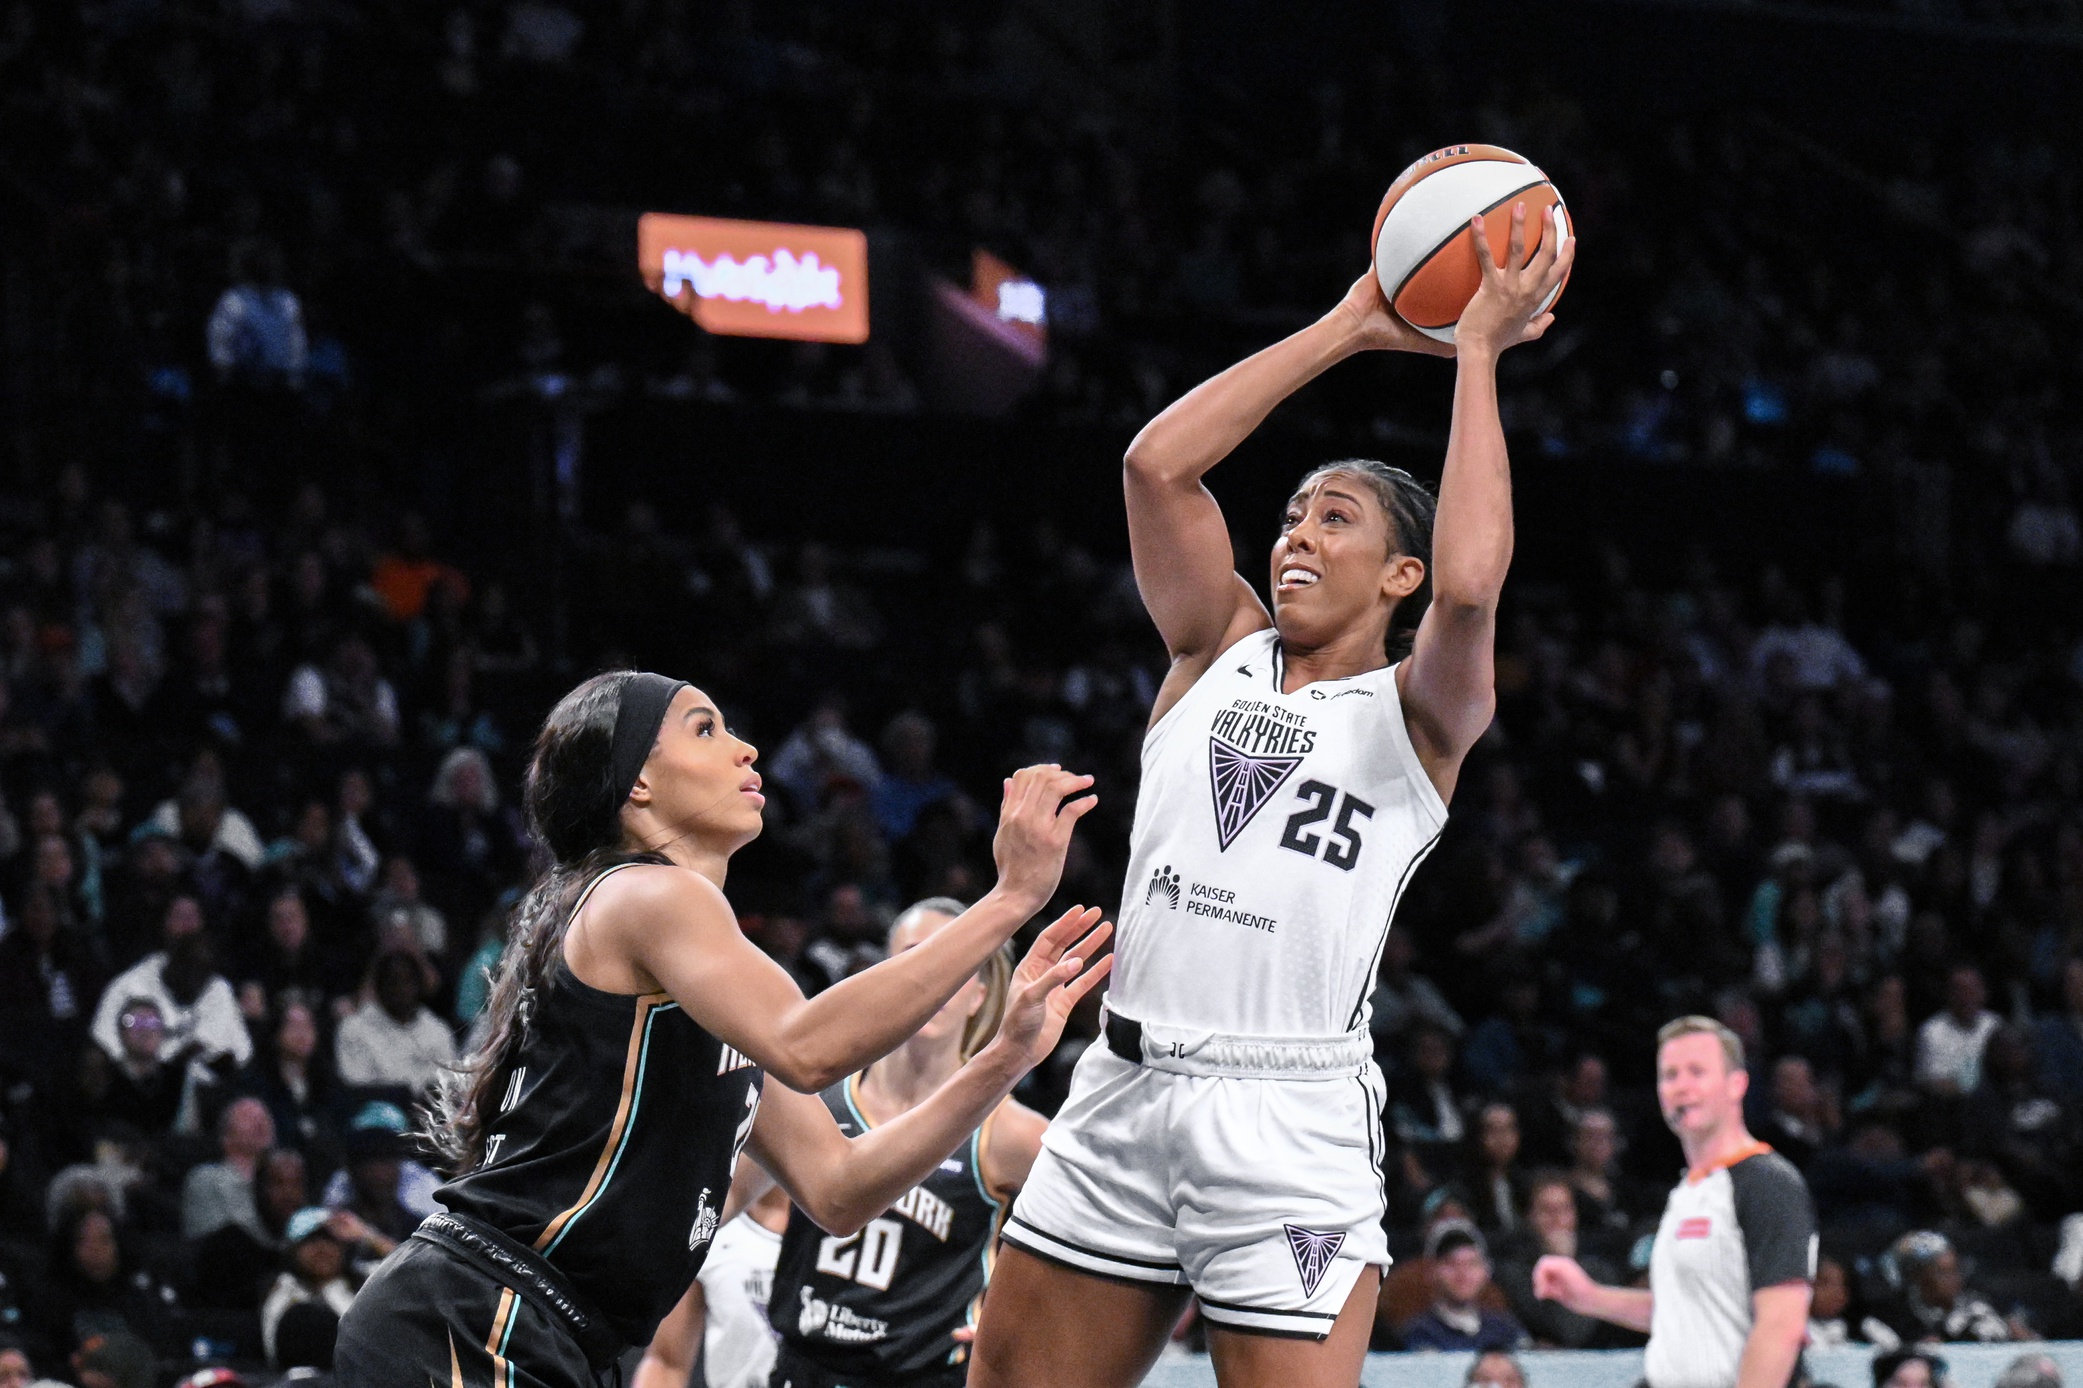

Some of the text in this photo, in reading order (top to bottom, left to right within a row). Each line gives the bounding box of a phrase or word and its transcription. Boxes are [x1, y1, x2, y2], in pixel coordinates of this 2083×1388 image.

[1210, 709, 1317, 755] VALKYRIES
[1272, 705, 1308, 728] STATE
[1277, 778, 1377, 874] 25
[1190, 882, 1236, 904] KAISER
[1186, 900, 1277, 933] PERMANENTE
[891, 1186, 955, 1243] ORK
[816, 1218, 904, 1292] 20
